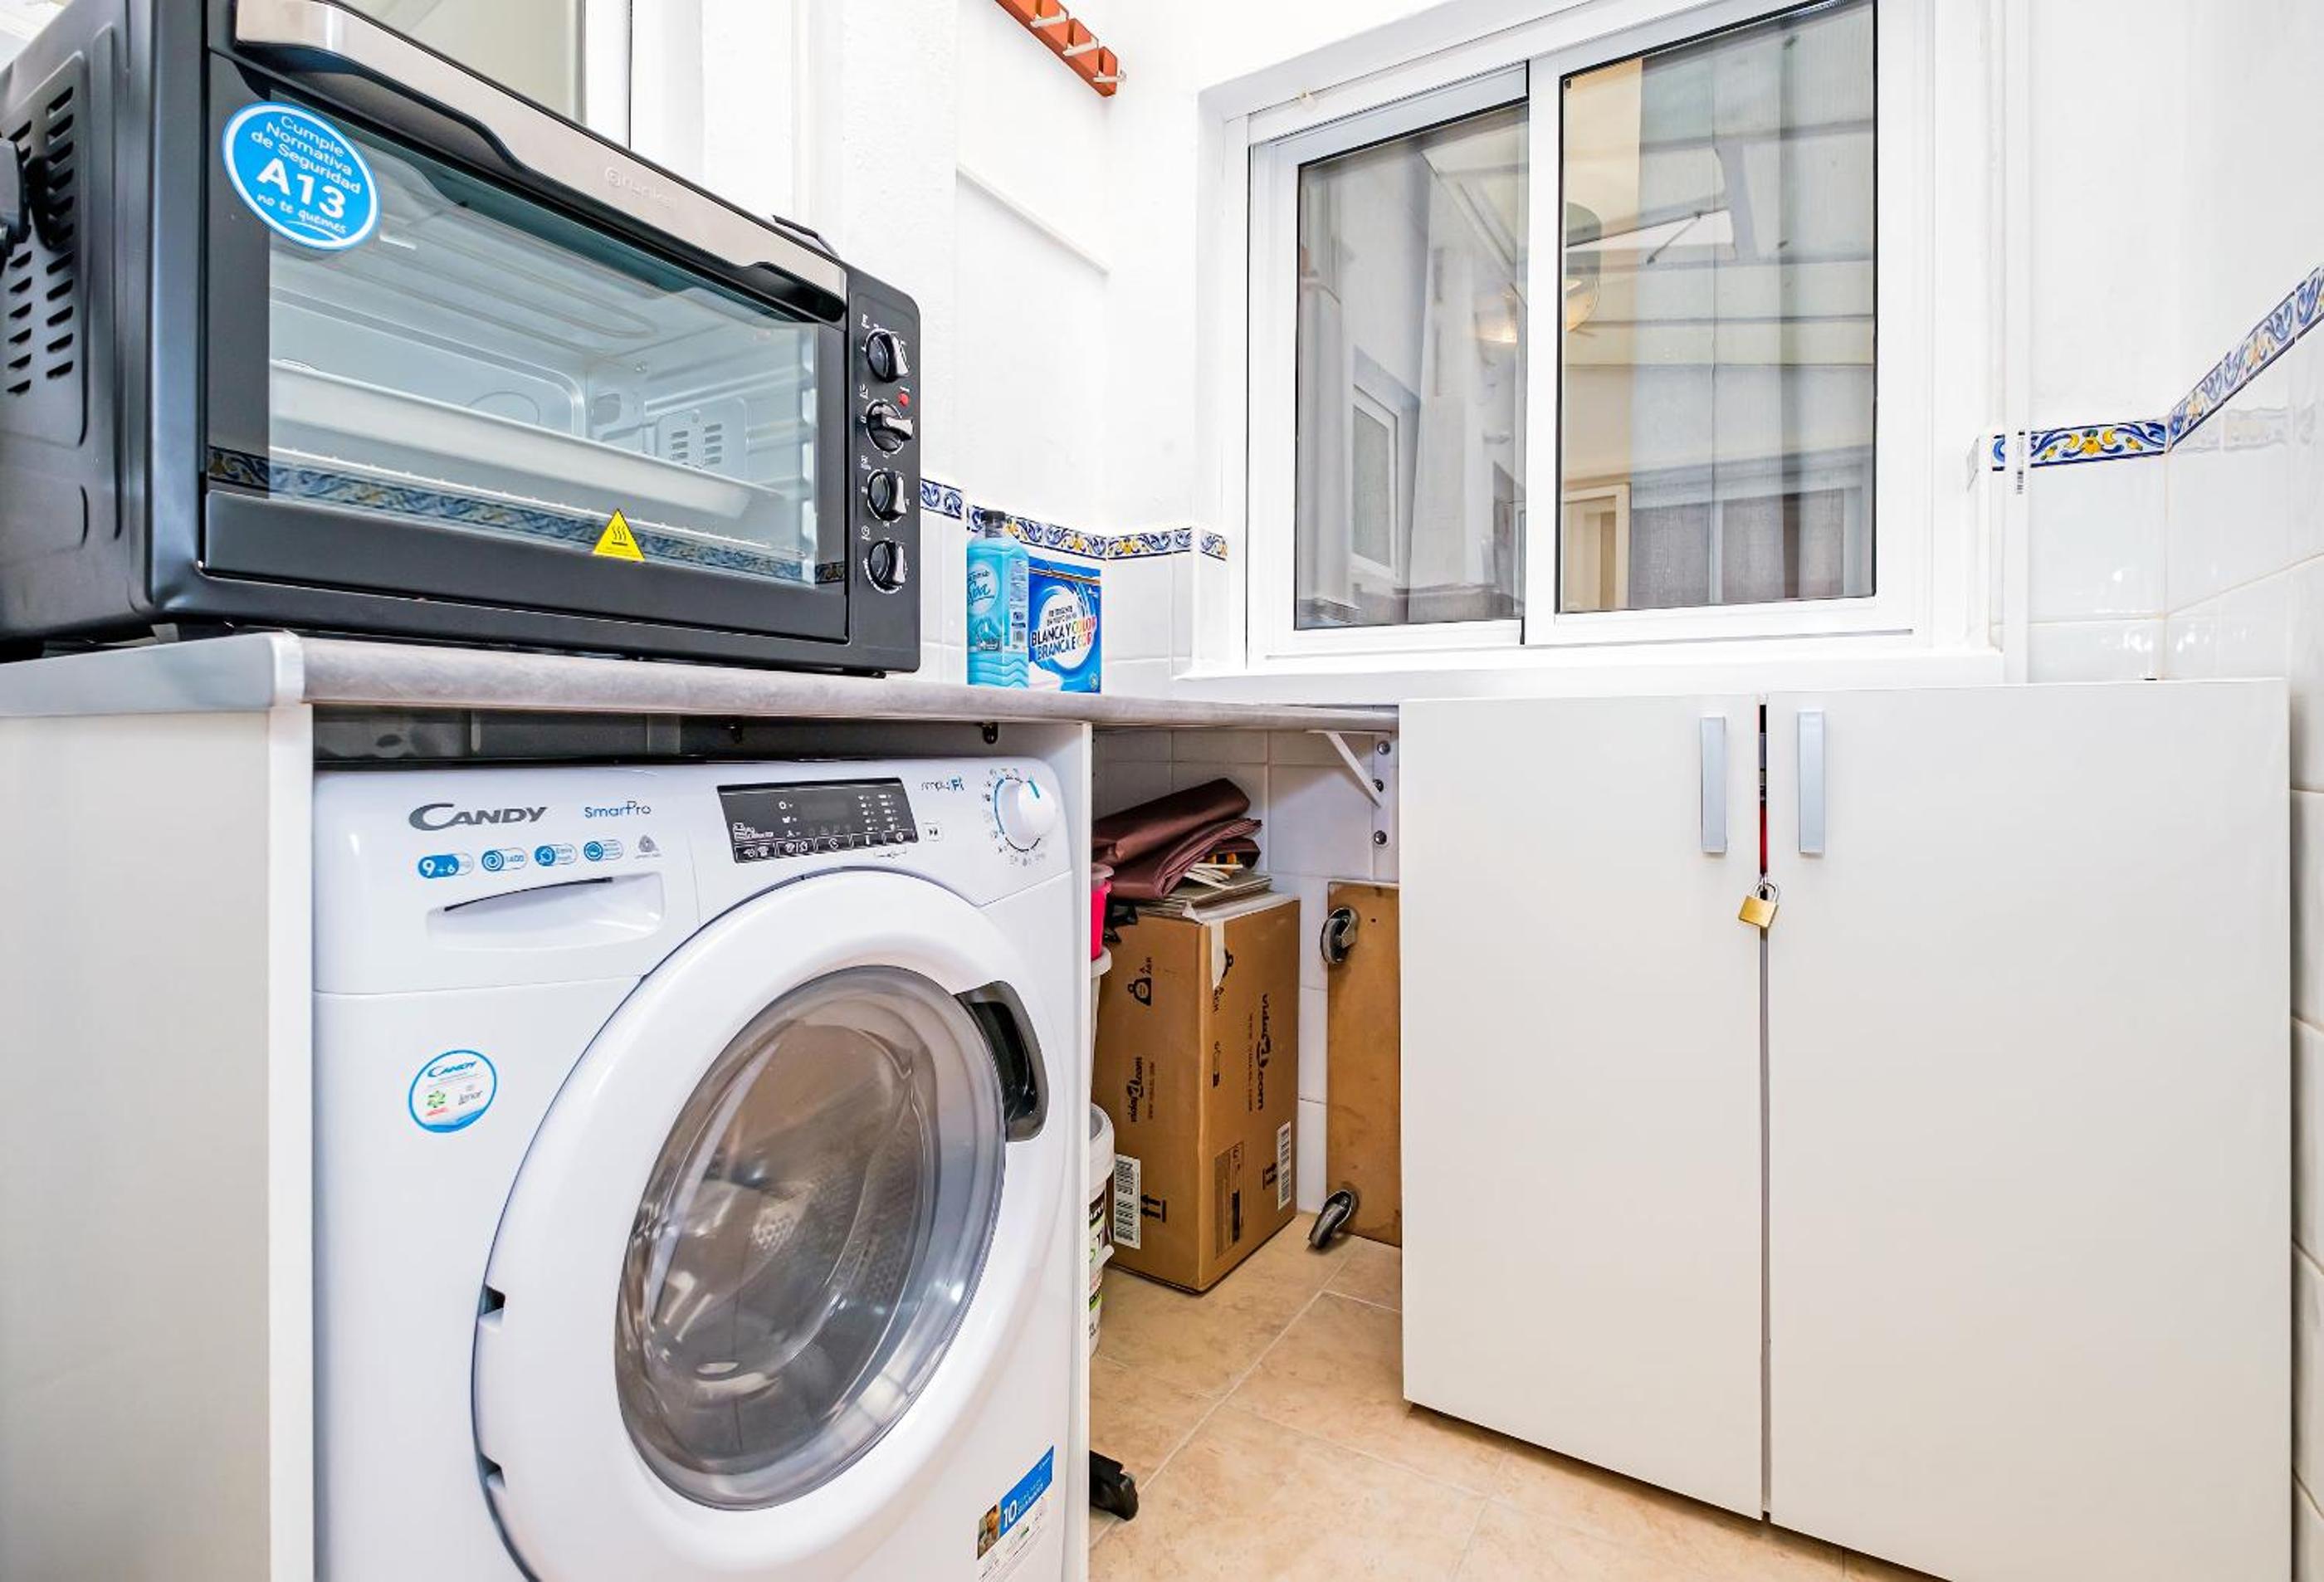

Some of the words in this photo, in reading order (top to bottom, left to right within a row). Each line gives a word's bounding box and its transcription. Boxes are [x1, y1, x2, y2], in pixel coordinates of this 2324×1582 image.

[266, 121, 353, 176] Normativa
[281, 115, 344, 157] Cumple
[251, 130, 274, 149] de
[278, 143, 362, 194] Seguridad
[256, 158, 347, 219] A13
[256, 193, 276, 207] no
[280, 201, 295, 214] te
[298, 209, 348, 235] quemes
[1031, 626, 1065, 647] BLANCA
[1066, 623, 1072, 637] Y
[408, 803, 549, 831] CANDY
[1003, 1499, 1018, 1529] 10
